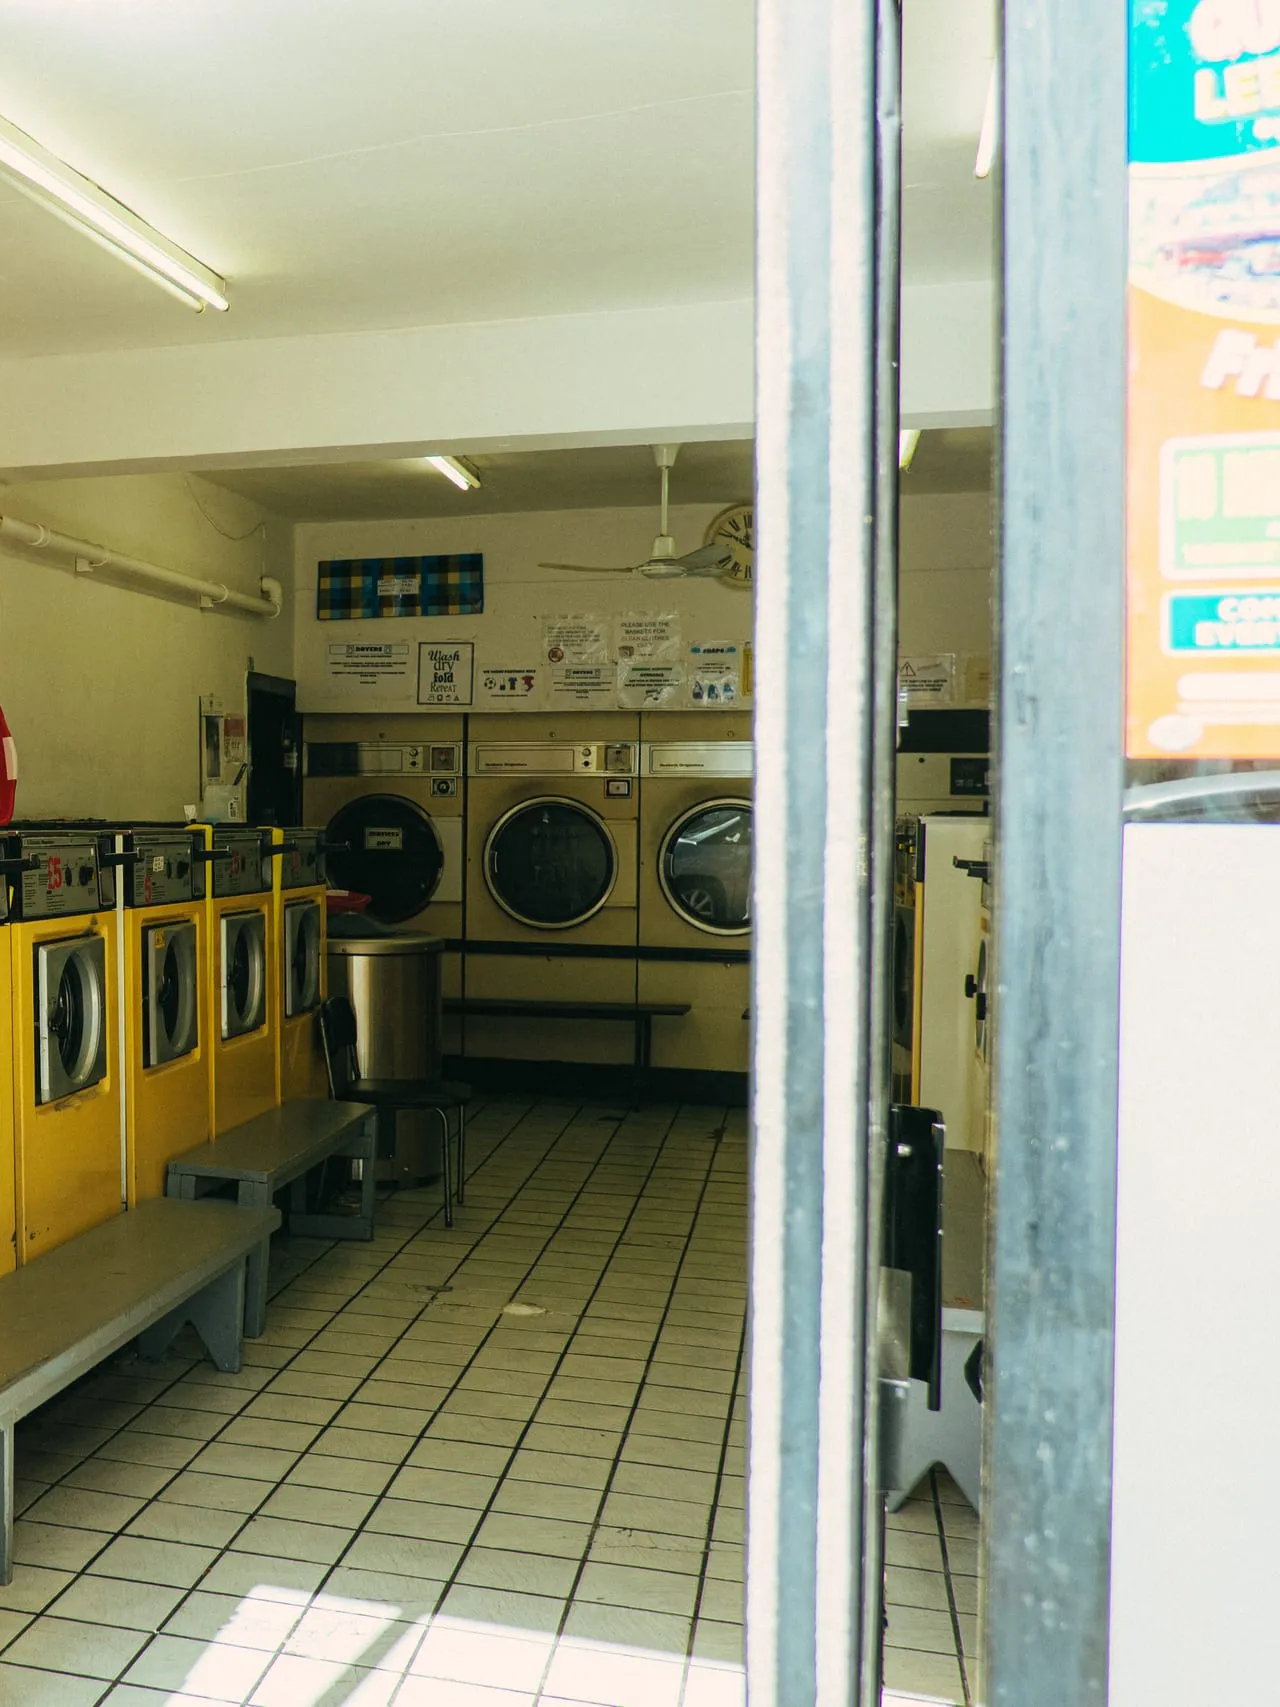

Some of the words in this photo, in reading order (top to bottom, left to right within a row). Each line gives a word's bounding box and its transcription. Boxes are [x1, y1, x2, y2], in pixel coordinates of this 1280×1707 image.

[428, 650, 460, 661] Wash
[433, 654, 454, 672] dry
[433, 672, 453, 683] fold
